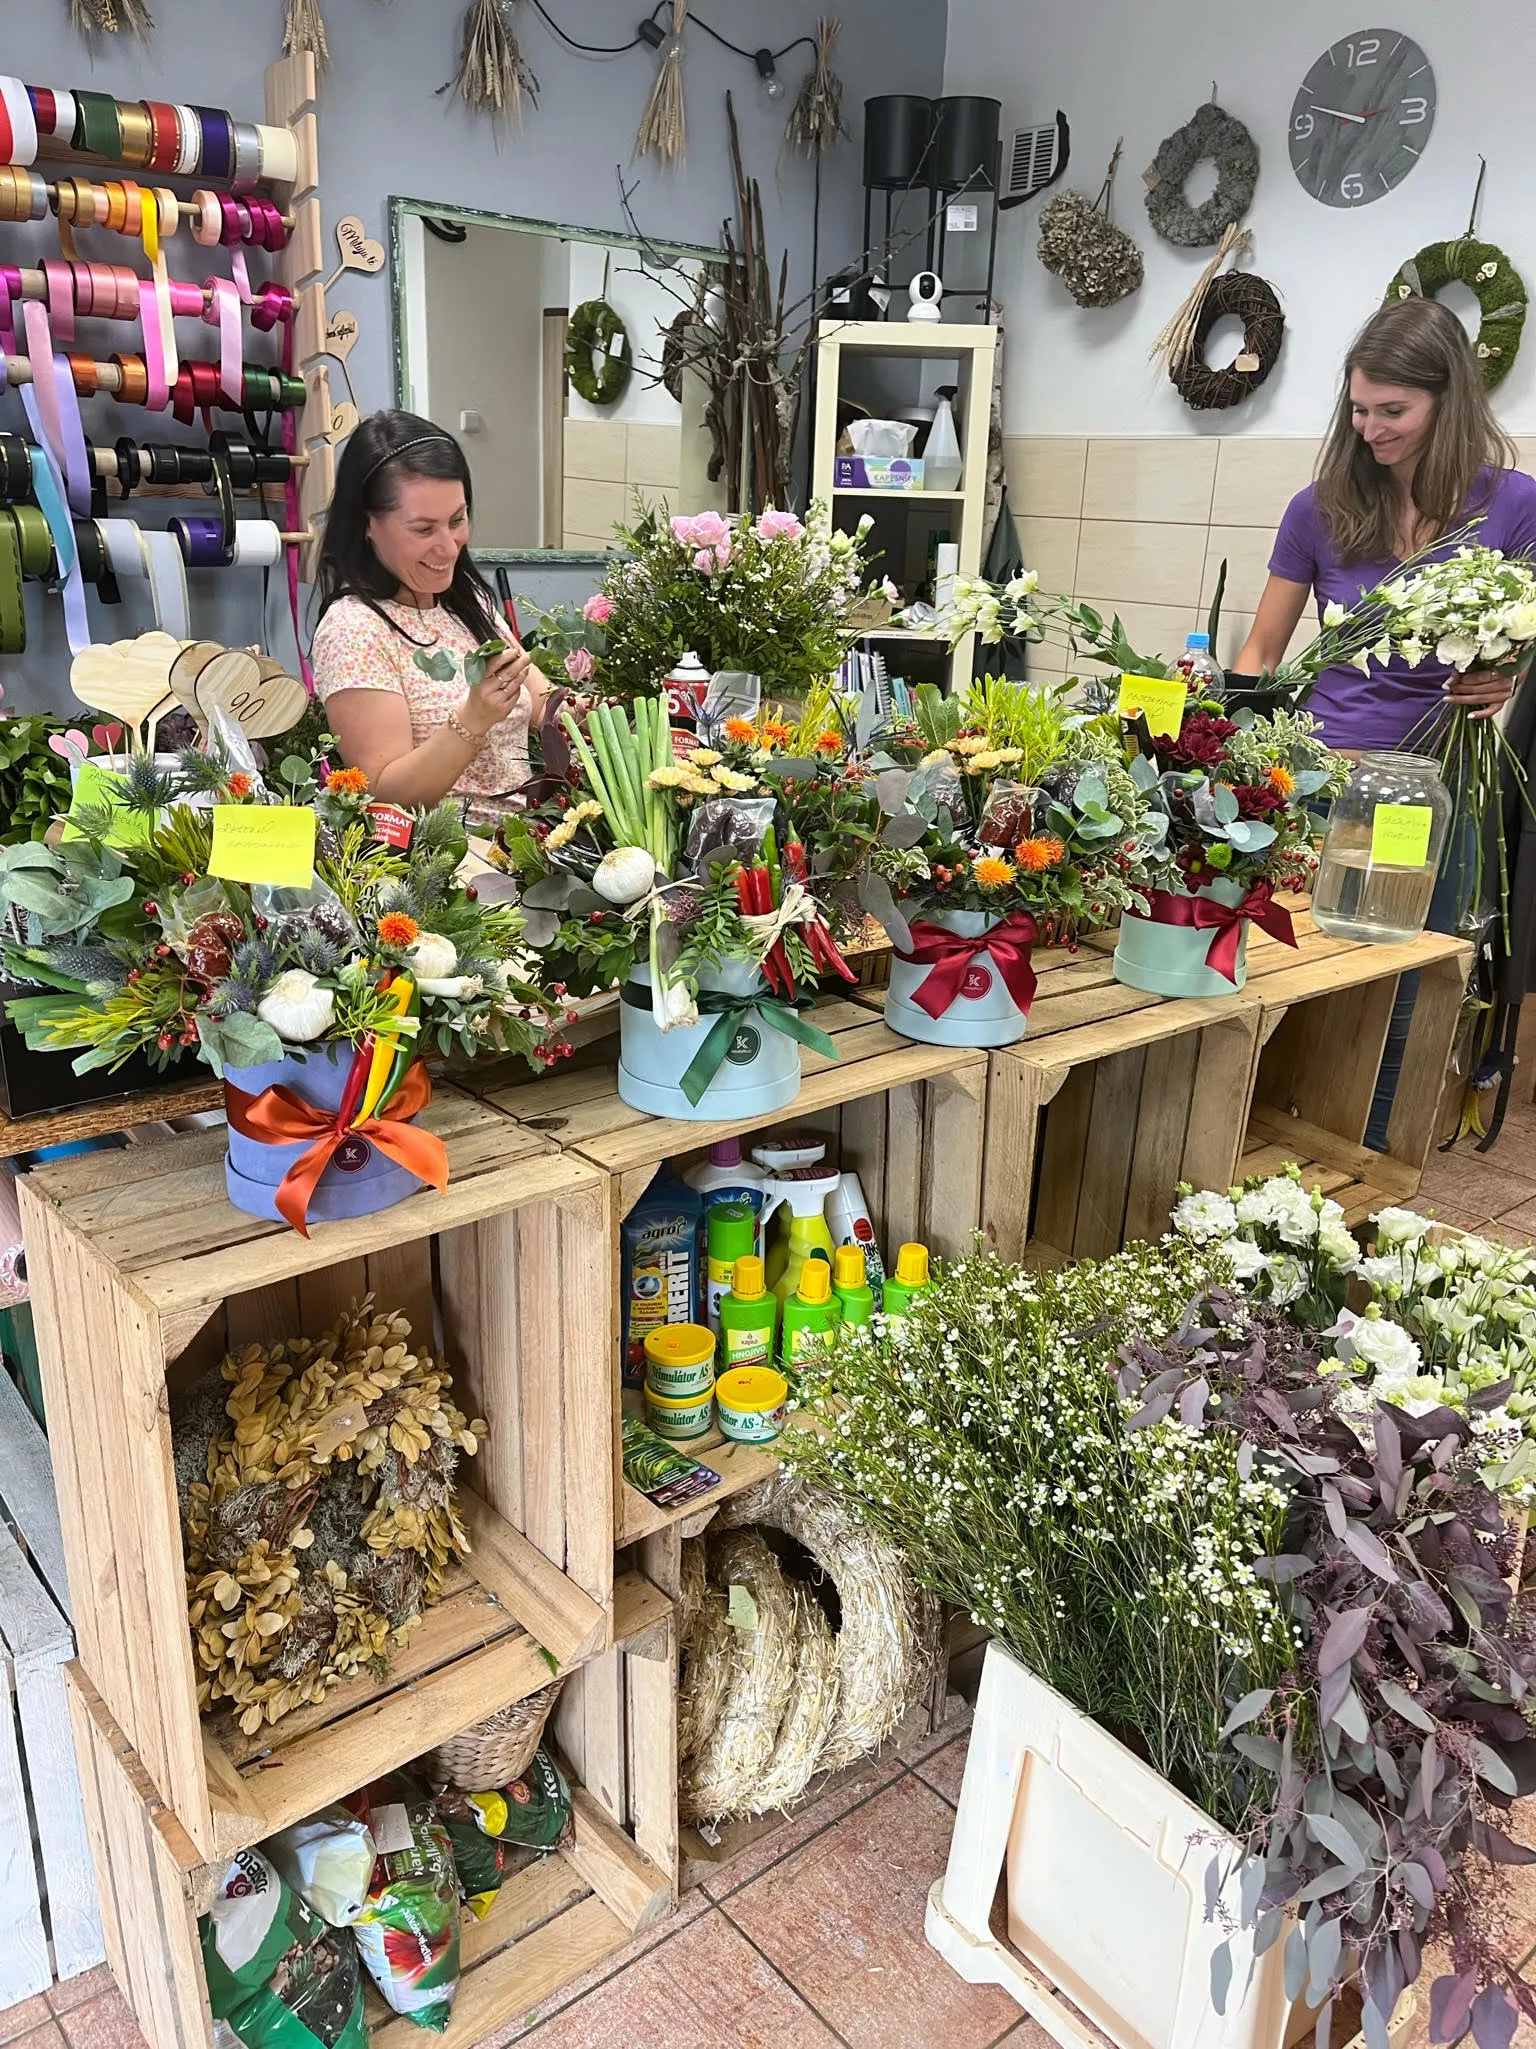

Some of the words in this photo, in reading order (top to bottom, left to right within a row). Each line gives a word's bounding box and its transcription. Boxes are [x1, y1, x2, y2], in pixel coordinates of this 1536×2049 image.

[1347, 38, 1380, 68] 12
[1399, 97, 1427, 125] 3
[1294, 114, 1314, 140] 9
[1341, 173, 1363, 200] 6
[333, 415, 343, 430] 0
[228, 692, 265, 722] 90
[667, 1250, 689, 1326] RERIT
[731, 1344, 766, 1360] HNOJIVO
[651, 1365, 697, 1383] Stimulátor
[651, 1407, 696, 1426] Stimulátor
